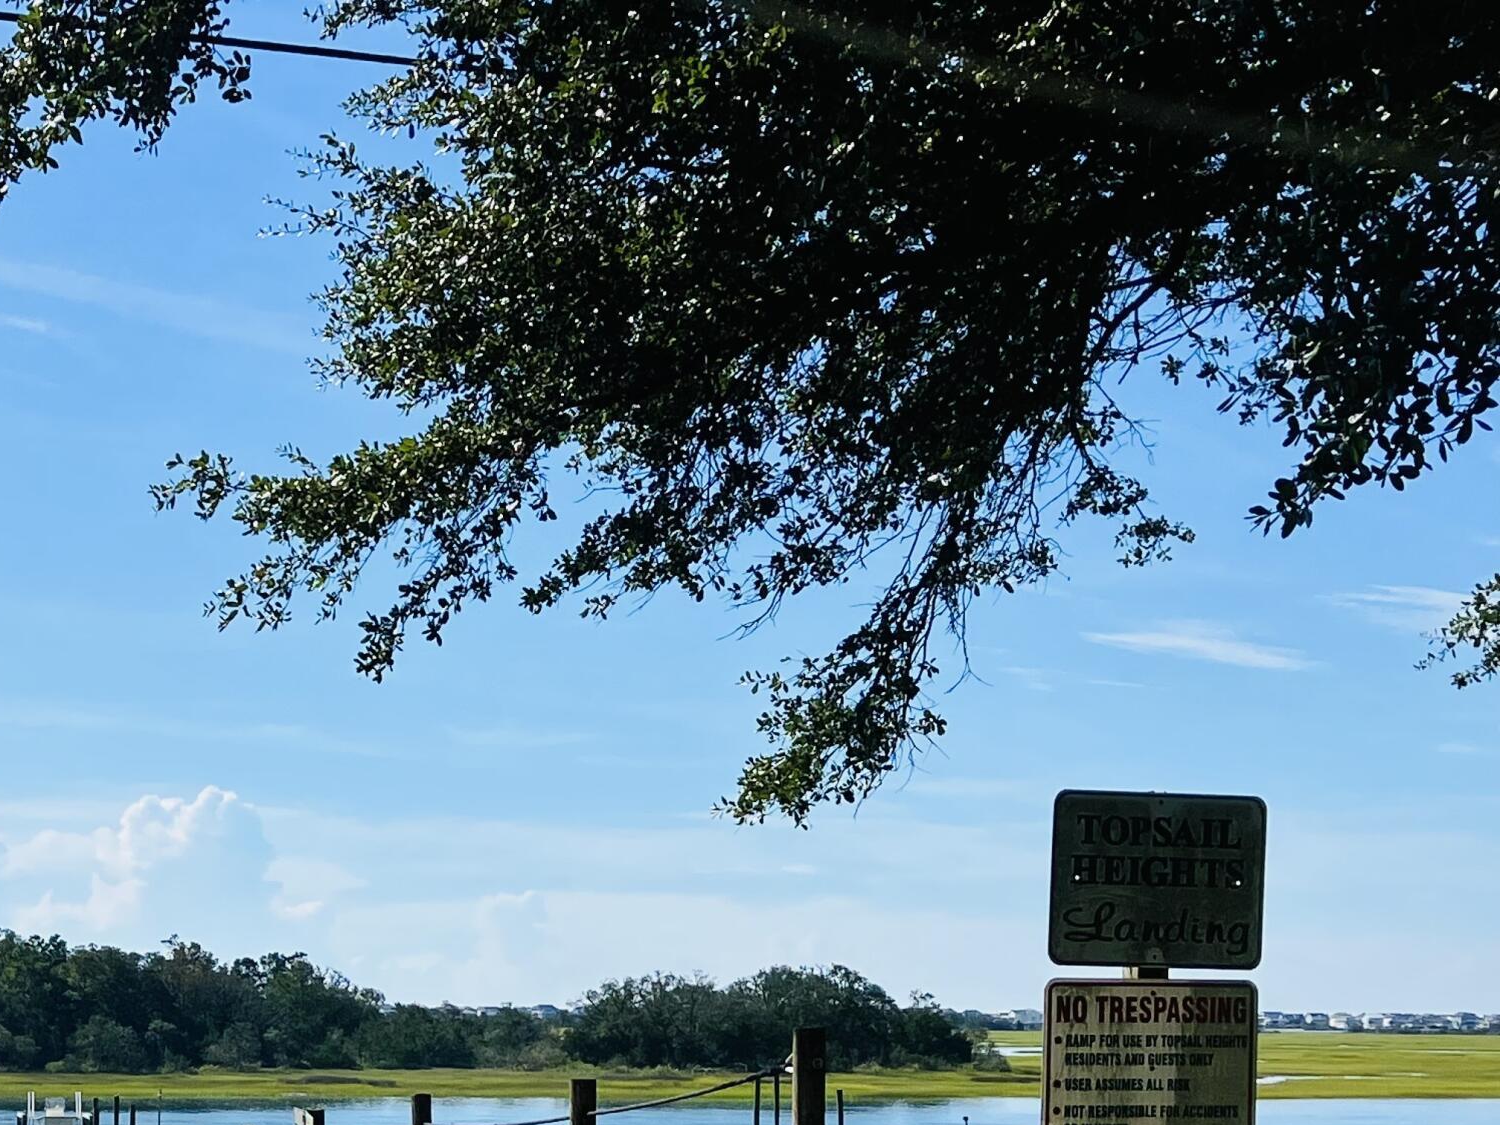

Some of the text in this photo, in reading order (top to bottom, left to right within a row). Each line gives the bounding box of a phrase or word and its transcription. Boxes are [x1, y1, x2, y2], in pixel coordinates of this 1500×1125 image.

[1077, 815, 1242, 849] TOPSAIL
[1070, 855, 1245, 889] HEIGHTS
[1062, 902, 1251, 956] Landing
[1056, 996, 1248, 1024] NO TRESPASSING
[1065, 1035, 1248, 1048] RAMP FOR USE BY TOPSAIL HEIGHTS
[1065, 1053, 1214, 1066] RESIDENTS AND GUESTS ONLY
[1065, 1078, 1190, 1091] USER ASSUMES ALL RISK
[1064, 1105, 1239, 1118] NOT RESPONSIBLE FOR ACCIDENTS
